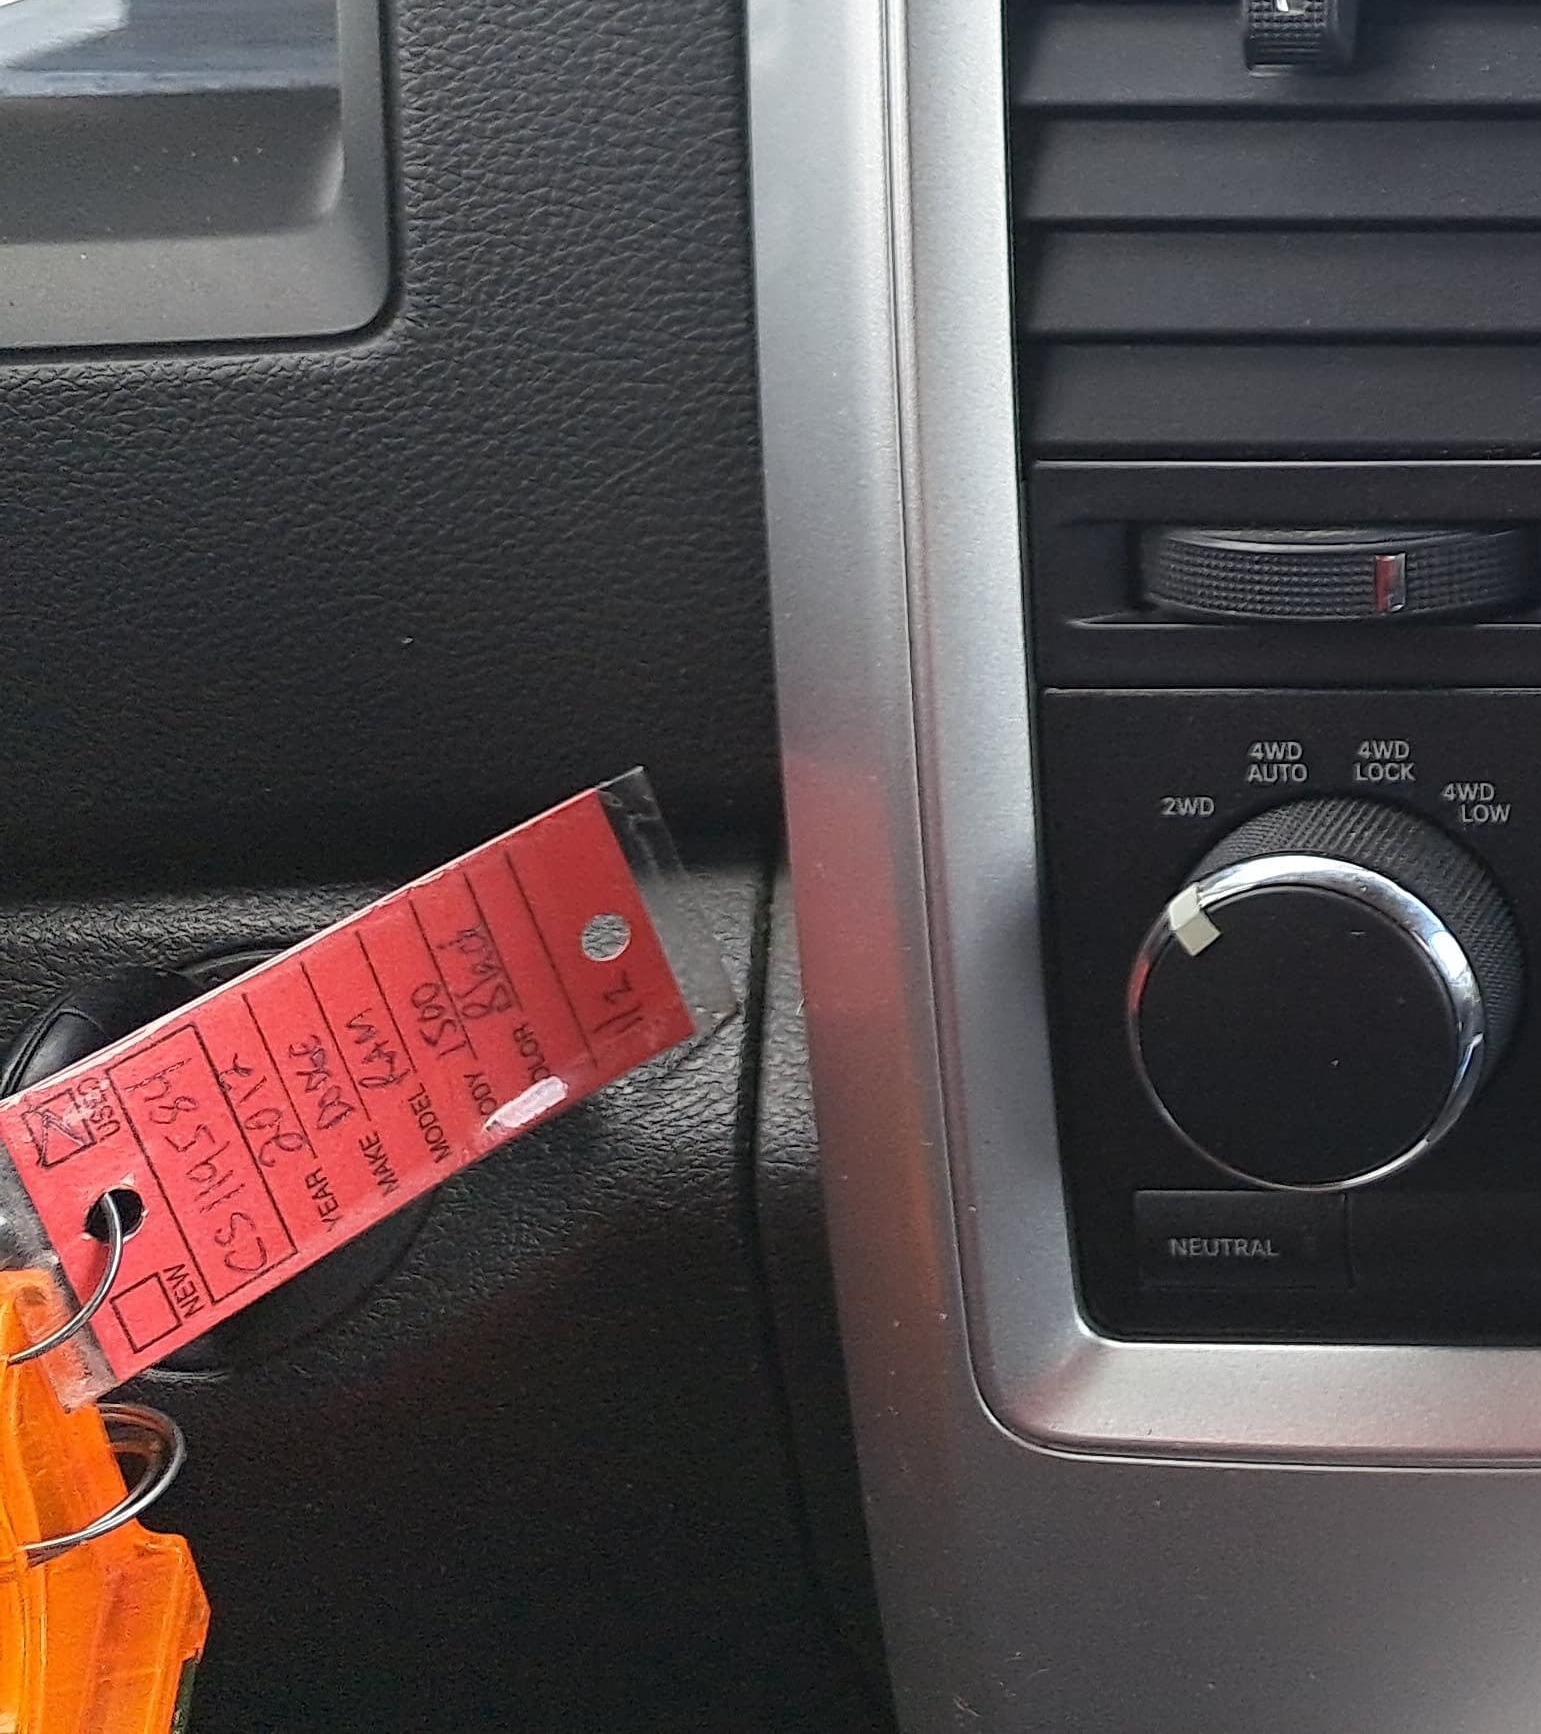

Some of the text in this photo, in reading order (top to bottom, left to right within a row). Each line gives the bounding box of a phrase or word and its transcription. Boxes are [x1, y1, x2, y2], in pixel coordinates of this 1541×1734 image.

[1247, 741, 1303, 762] 4WD
[1356, 740, 1411, 761] 4WD
[1246, 762, 1309, 783] AUTO
[1354, 761, 1416, 782] LOCK
[1441, 782, 1496, 804] 4WD
[1160, 797, 1216, 818] 2WD
[1460, 803, 1511, 824] LOW
[410, 981, 499, 1117] ODY 1500
[512, 1022, 551, 1085] OLOR
[346, 1007, 453, 1164] MODEL RAM
[218, 1052, 341, 1233] YEAR 2012
[358, 1129, 400, 1197] MAKE
[1168, 1237, 1279, 1258] NEUTRAL
[163, 1263, 205, 1320] NEW
